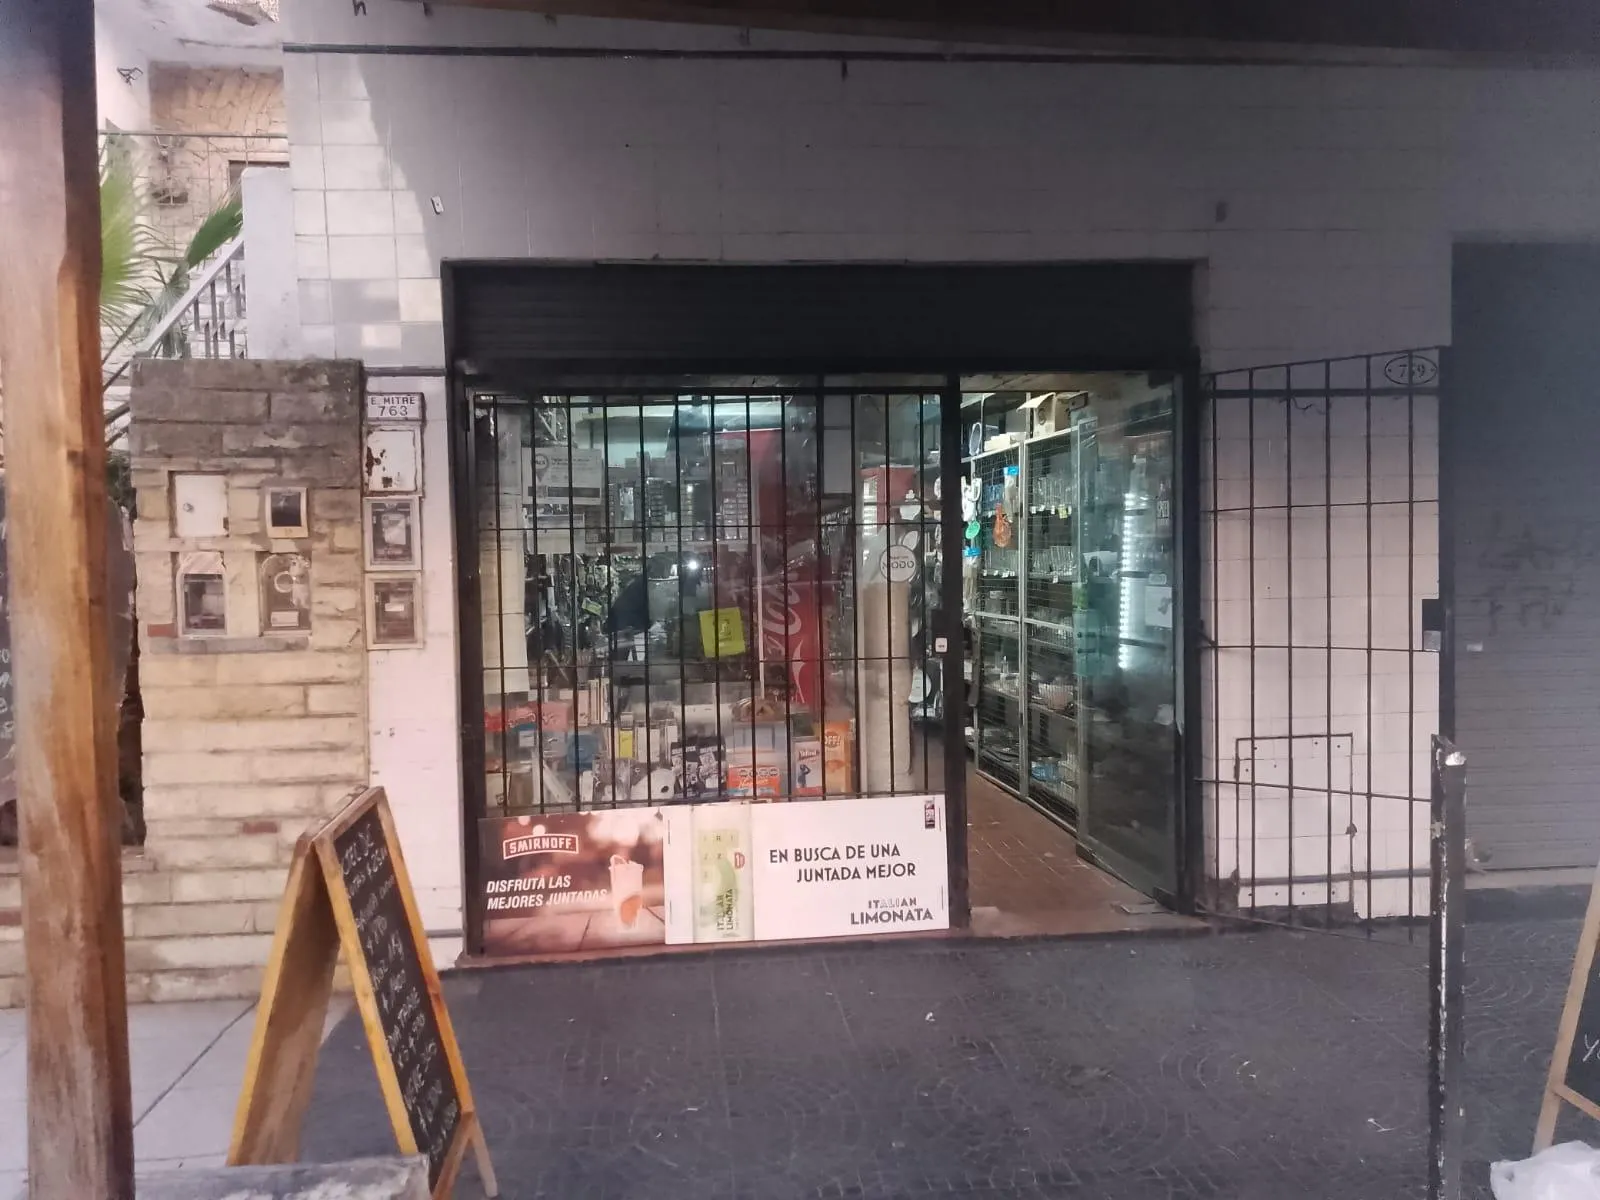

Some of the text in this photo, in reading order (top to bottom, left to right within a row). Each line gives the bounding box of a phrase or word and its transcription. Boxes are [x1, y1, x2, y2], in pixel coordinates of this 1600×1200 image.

[1399, 364, 1425, 378] 79
[383, 396, 416, 405] MITRE
[379, 405, 408, 416] 763
[509, 836, 572, 854] SMIRNOFF
[769, 843, 901, 863] EN BUSCA DE UNA
[796, 862, 916, 883] JUNTADA MEJOR
[548, 874, 572, 889] LAS
[487, 888, 608, 910] MEJORES JUNTADAS
[868, 897, 917, 909] ITALIAN
[850, 908, 934, 925] LIMONATA
